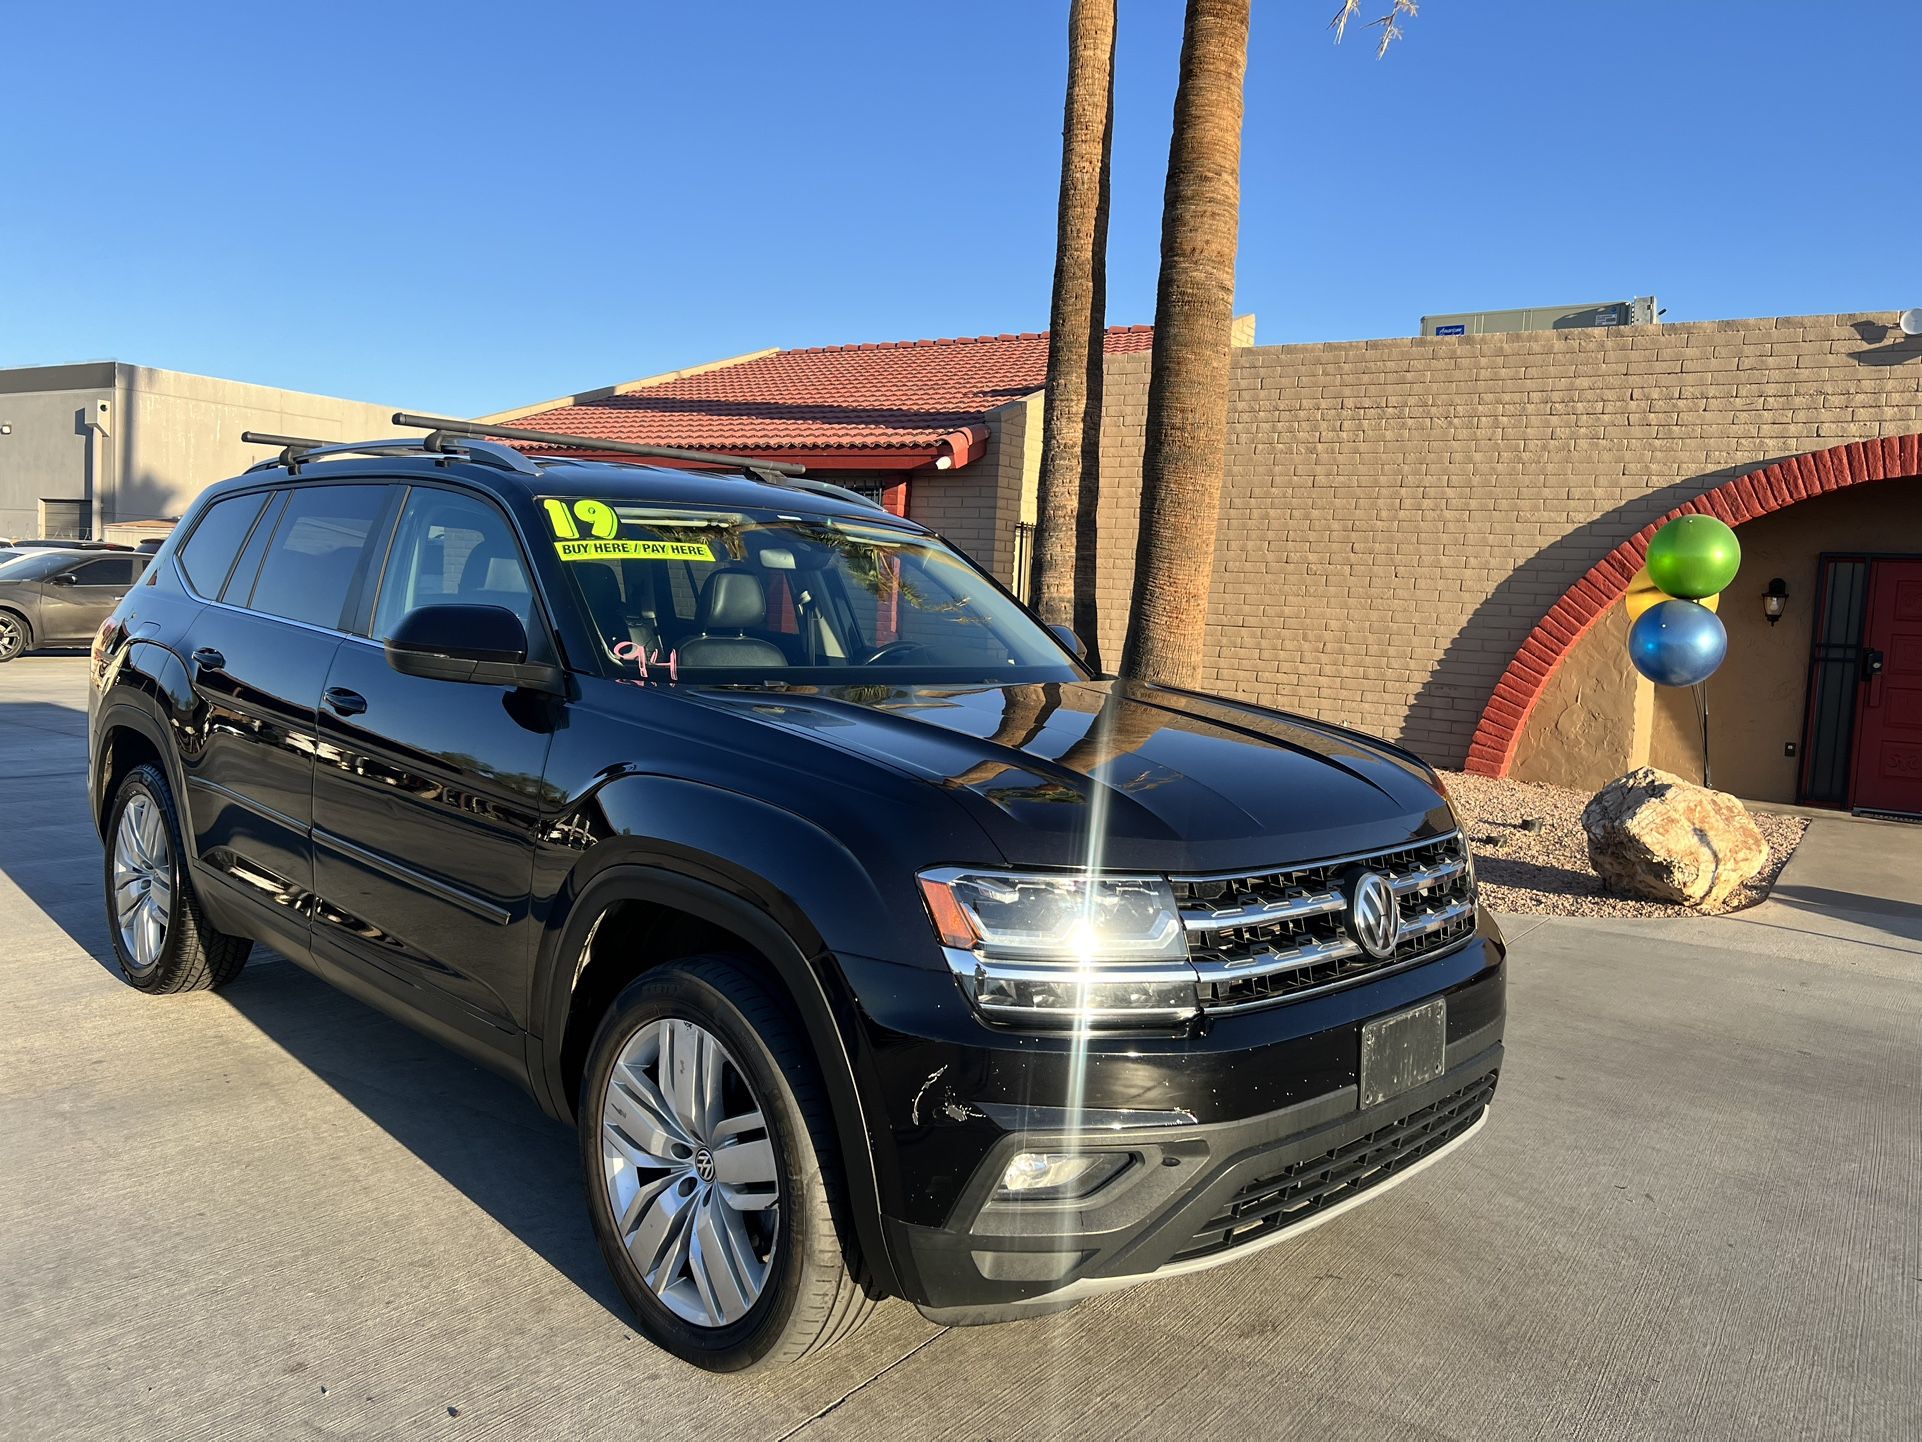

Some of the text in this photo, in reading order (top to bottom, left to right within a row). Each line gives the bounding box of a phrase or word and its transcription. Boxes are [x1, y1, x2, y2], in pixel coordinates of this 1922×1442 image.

[543, 499, 618, 539] 19
[562, 543, 588, 554] BUY
[594, 543, 630, 553] HERE
[642, 543, 666, 553] PAY
[671, 545, 704, 556] HERE
[613, 641, 678, 680] 94
